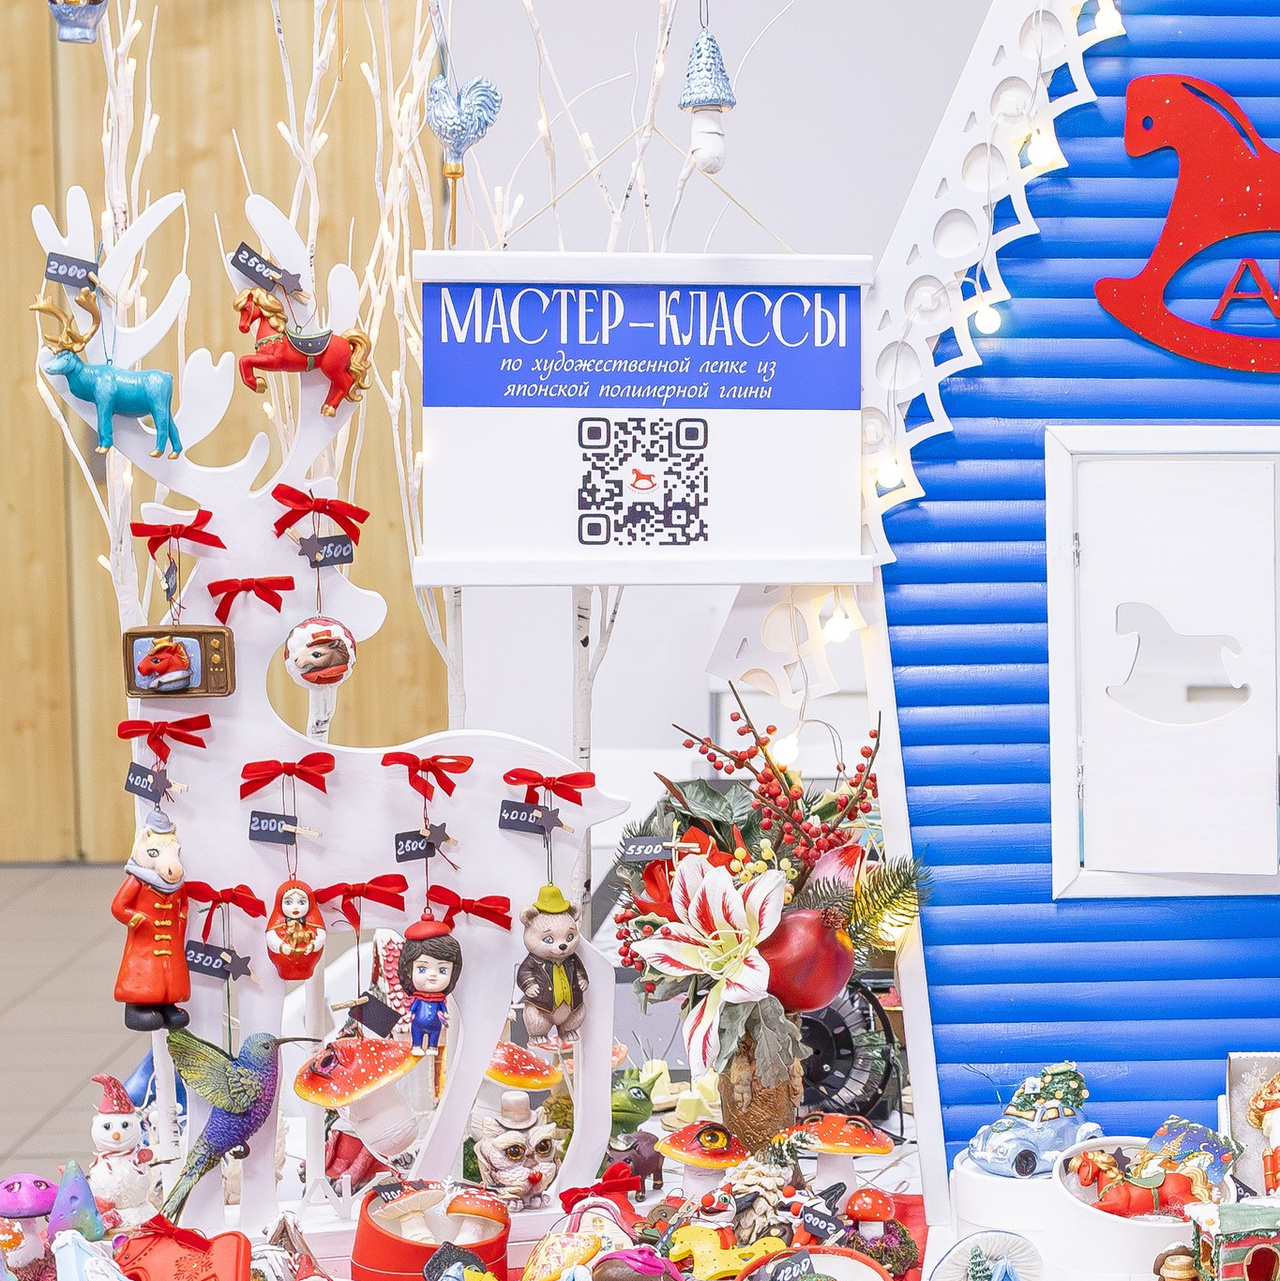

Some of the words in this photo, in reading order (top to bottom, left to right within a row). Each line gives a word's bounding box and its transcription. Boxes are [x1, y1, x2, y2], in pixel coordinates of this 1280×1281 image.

[47, 260, 88, 280] 2000
[237, 250, 276, 280] 2500
[440, 287, 847, 348] МАСТЕР-КЛАССЫ
[500, 357, 523, 372] по
[531, 350, 691, 381] художественной
[698, 360, 748, 375] лепке
[757, 360, 777, 382] из
[503, 381, 590, 398] японской
[598, 382, 710, 406] полимерной
[718, 385, 773, 399] глины
[502, 808, 536, 824] 4000
[625, 844, 663, 856] 5500
[186, 949, 223, 969] 2500
